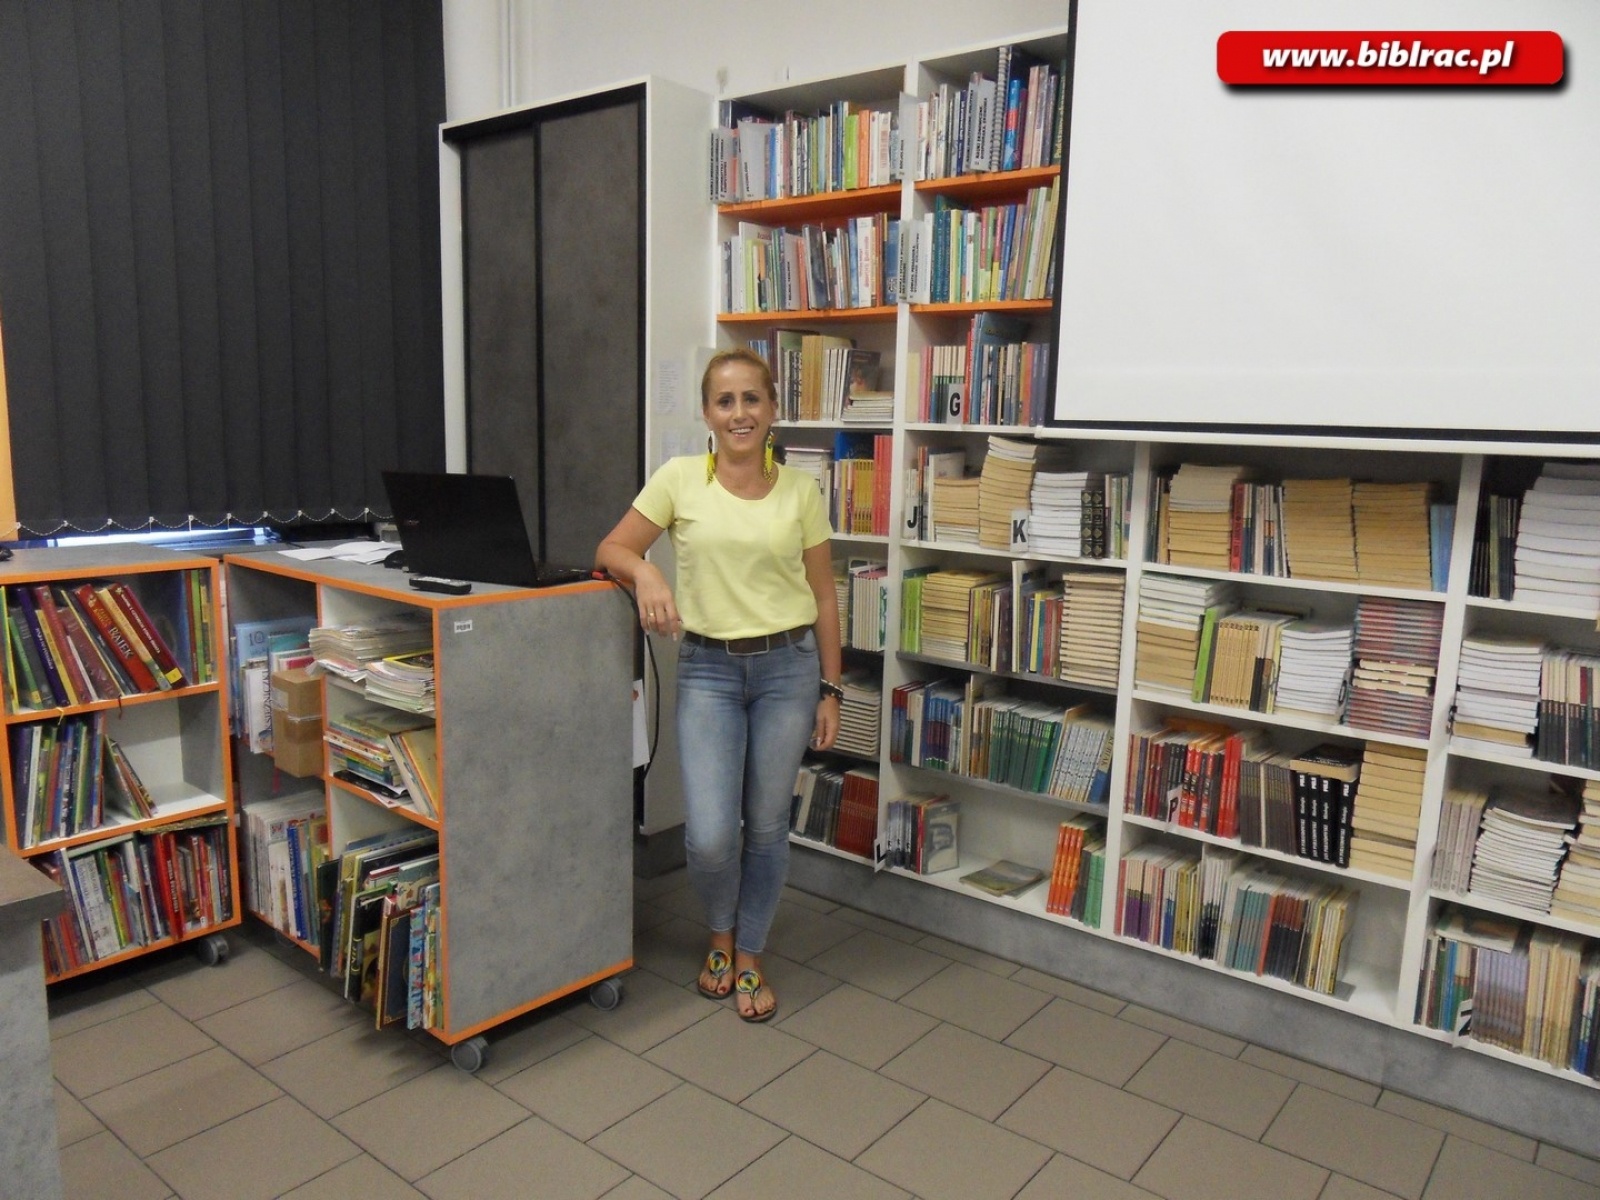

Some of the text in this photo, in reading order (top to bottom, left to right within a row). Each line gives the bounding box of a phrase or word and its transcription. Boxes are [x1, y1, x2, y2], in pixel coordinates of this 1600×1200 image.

[950, 392, 960, 417] G
[907, 506, 918, 528] J
[1013, 519, 1026, 544] K
[1170, 798, 1179, 822] P
[1458, 1009, 1472, 1036] Z
